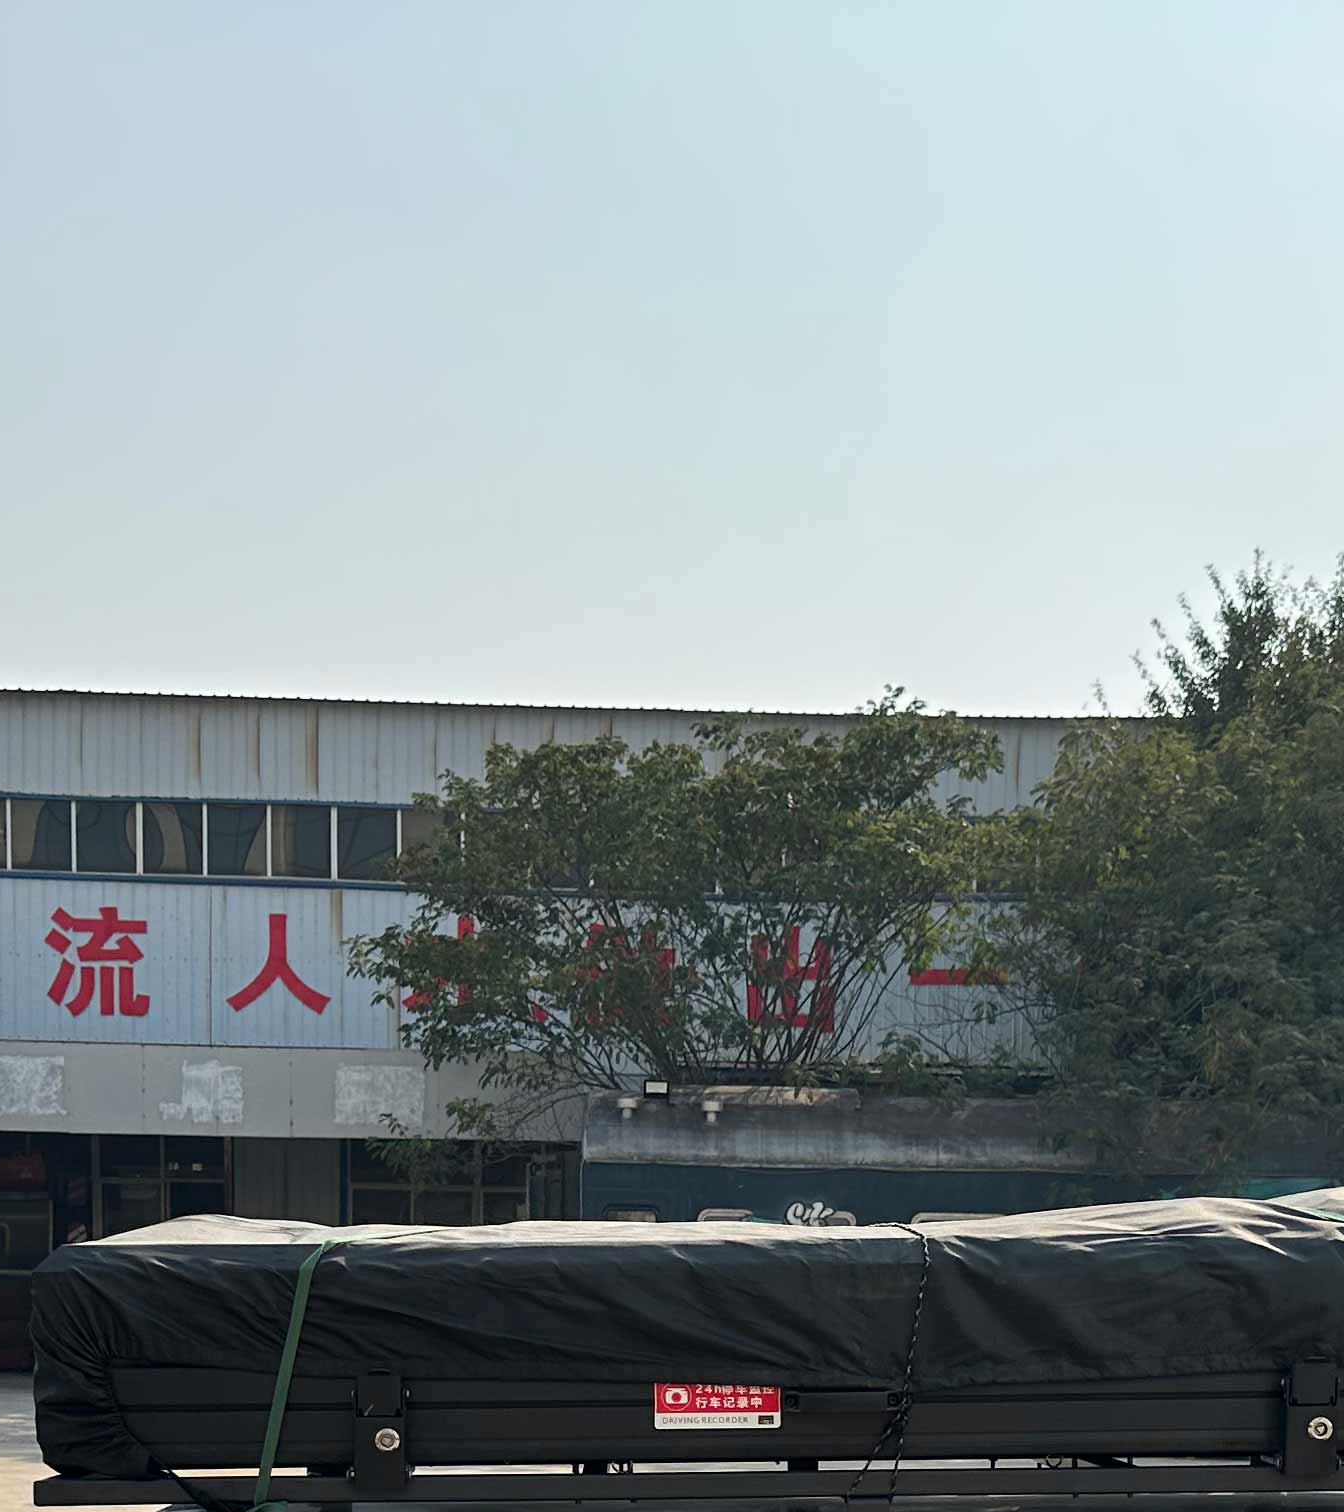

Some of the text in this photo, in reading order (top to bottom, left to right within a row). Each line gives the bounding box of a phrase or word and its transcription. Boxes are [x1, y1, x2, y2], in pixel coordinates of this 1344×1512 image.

[695, 1396, 763, 1409] 行车记录中
[662, 1416, 699, 1424] DRIVING
[701, 1416, 749, 1424] RECORDER
